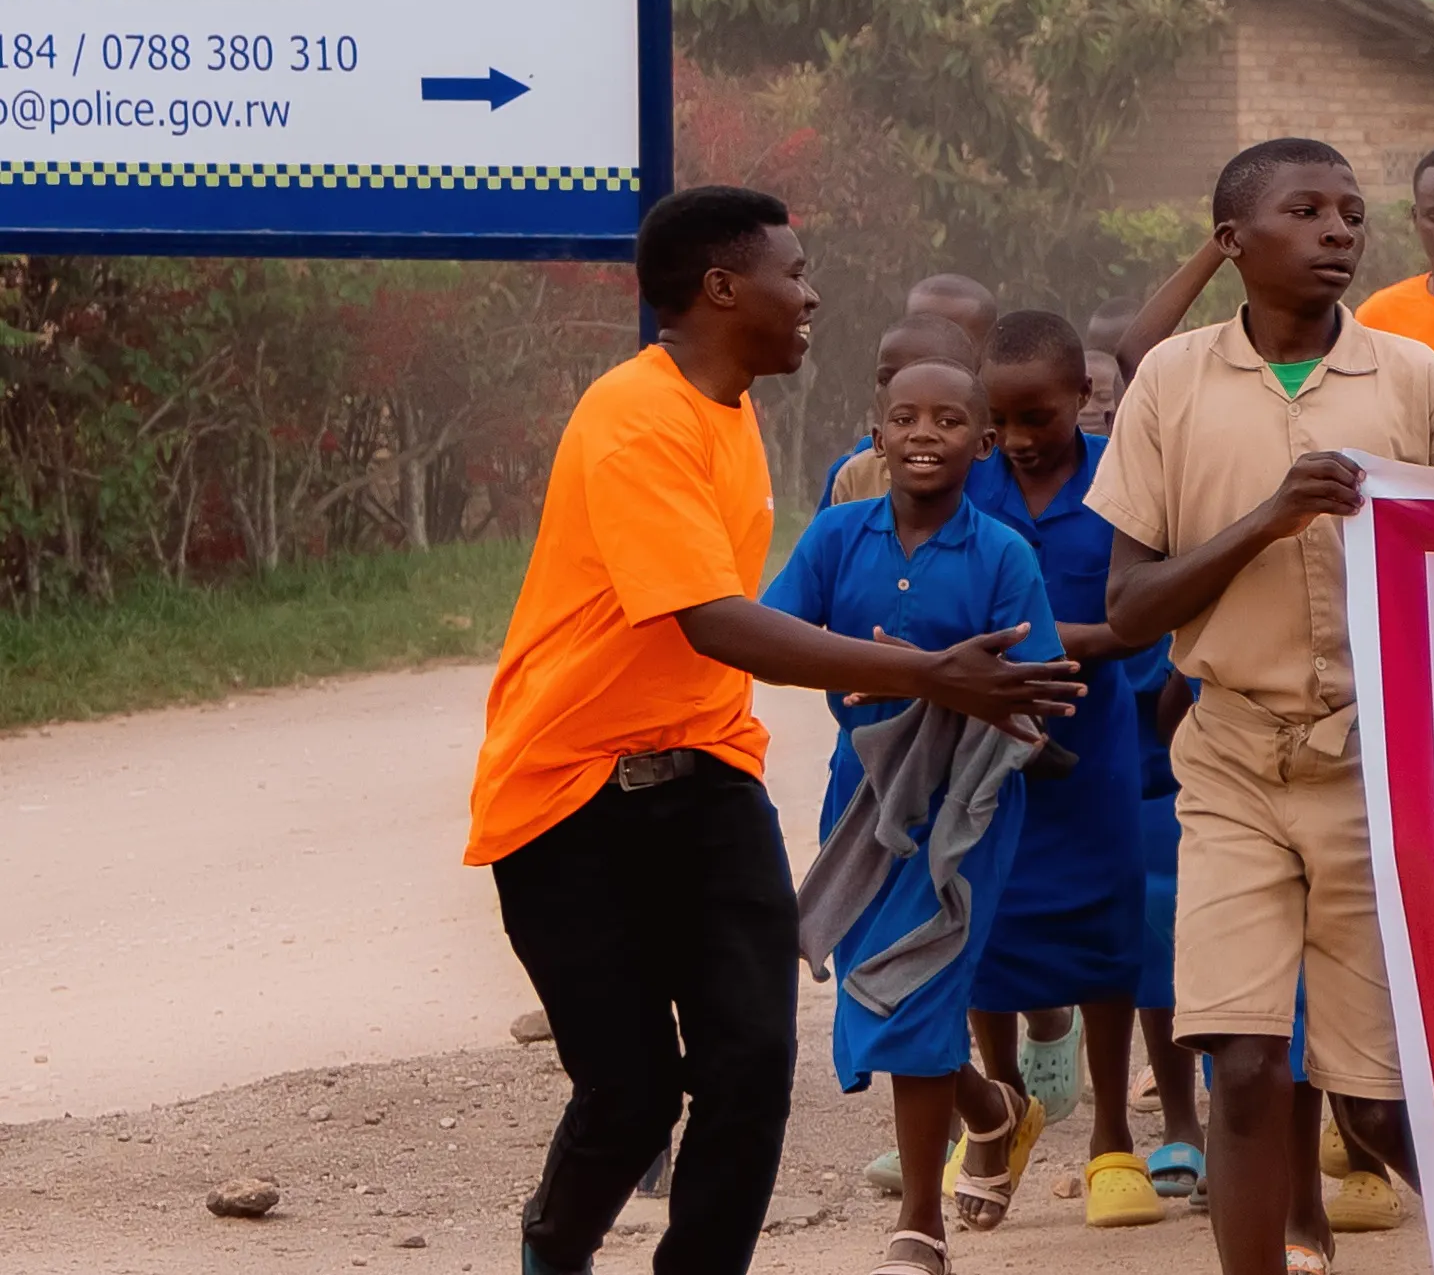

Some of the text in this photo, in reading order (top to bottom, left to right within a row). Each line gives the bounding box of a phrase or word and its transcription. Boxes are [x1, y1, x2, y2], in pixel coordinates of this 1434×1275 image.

[103, 34, 191, 71] 0788
[207, 34, 274, 72] 380
[290, 35, 358, 72] 310
